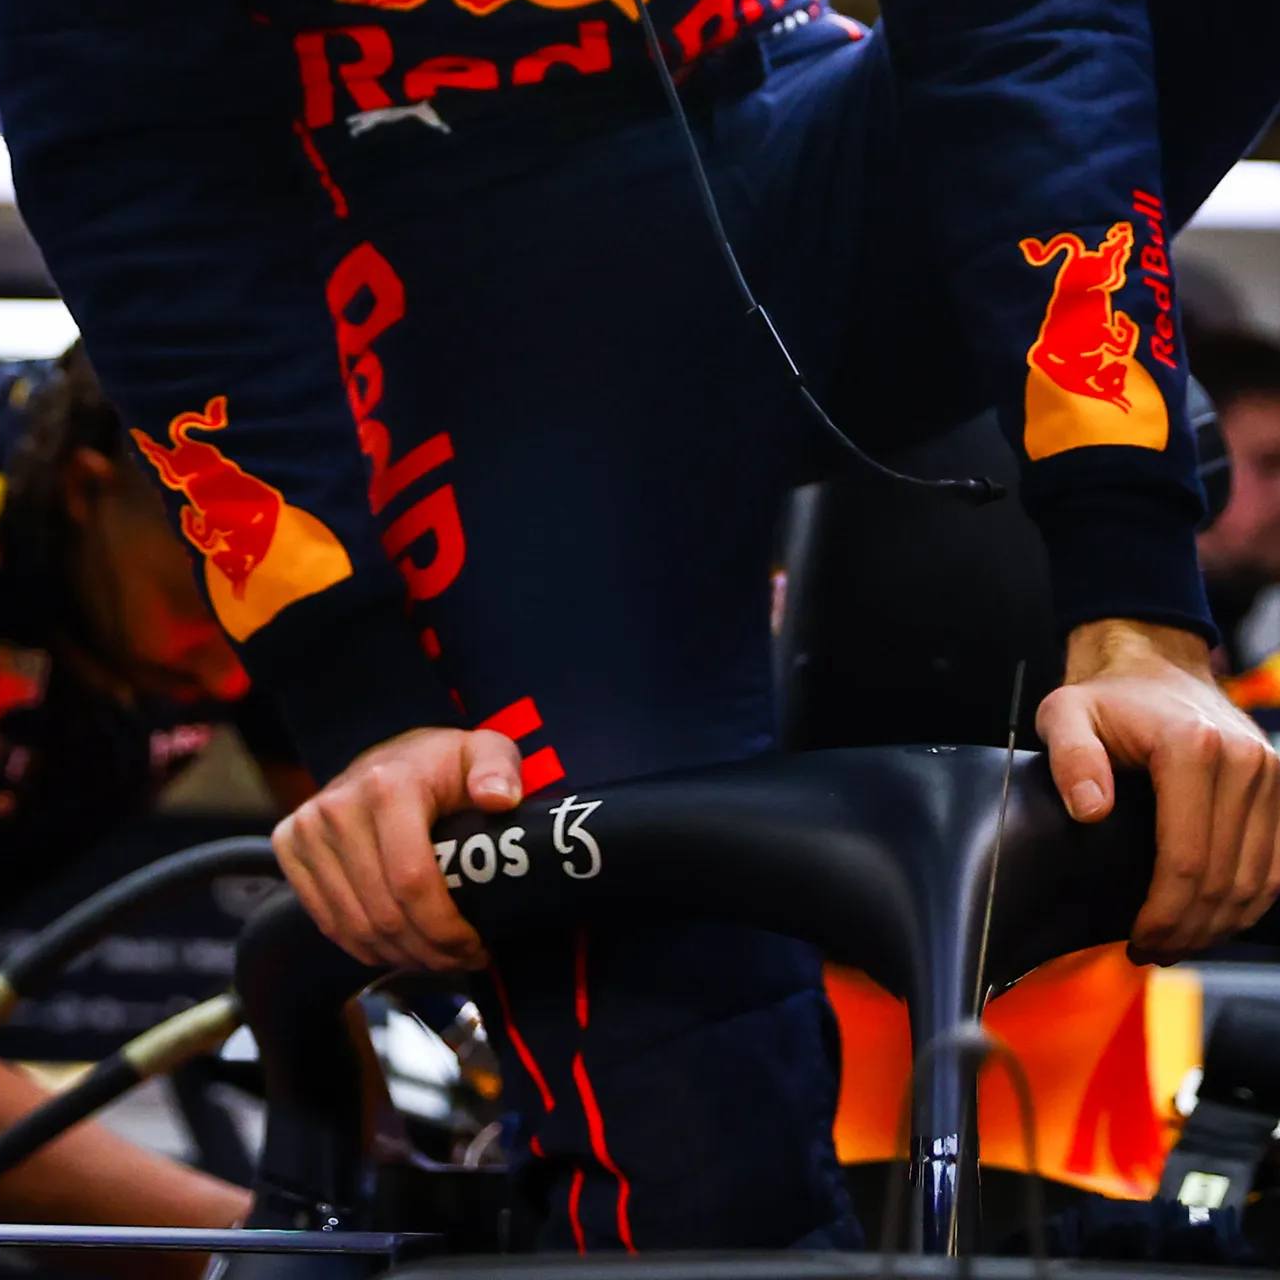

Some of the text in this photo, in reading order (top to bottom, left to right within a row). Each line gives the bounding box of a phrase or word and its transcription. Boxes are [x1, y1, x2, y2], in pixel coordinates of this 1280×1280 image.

[1132, 188, 1178, 370] Red Bull
[433, 827, 530, 889] zos
